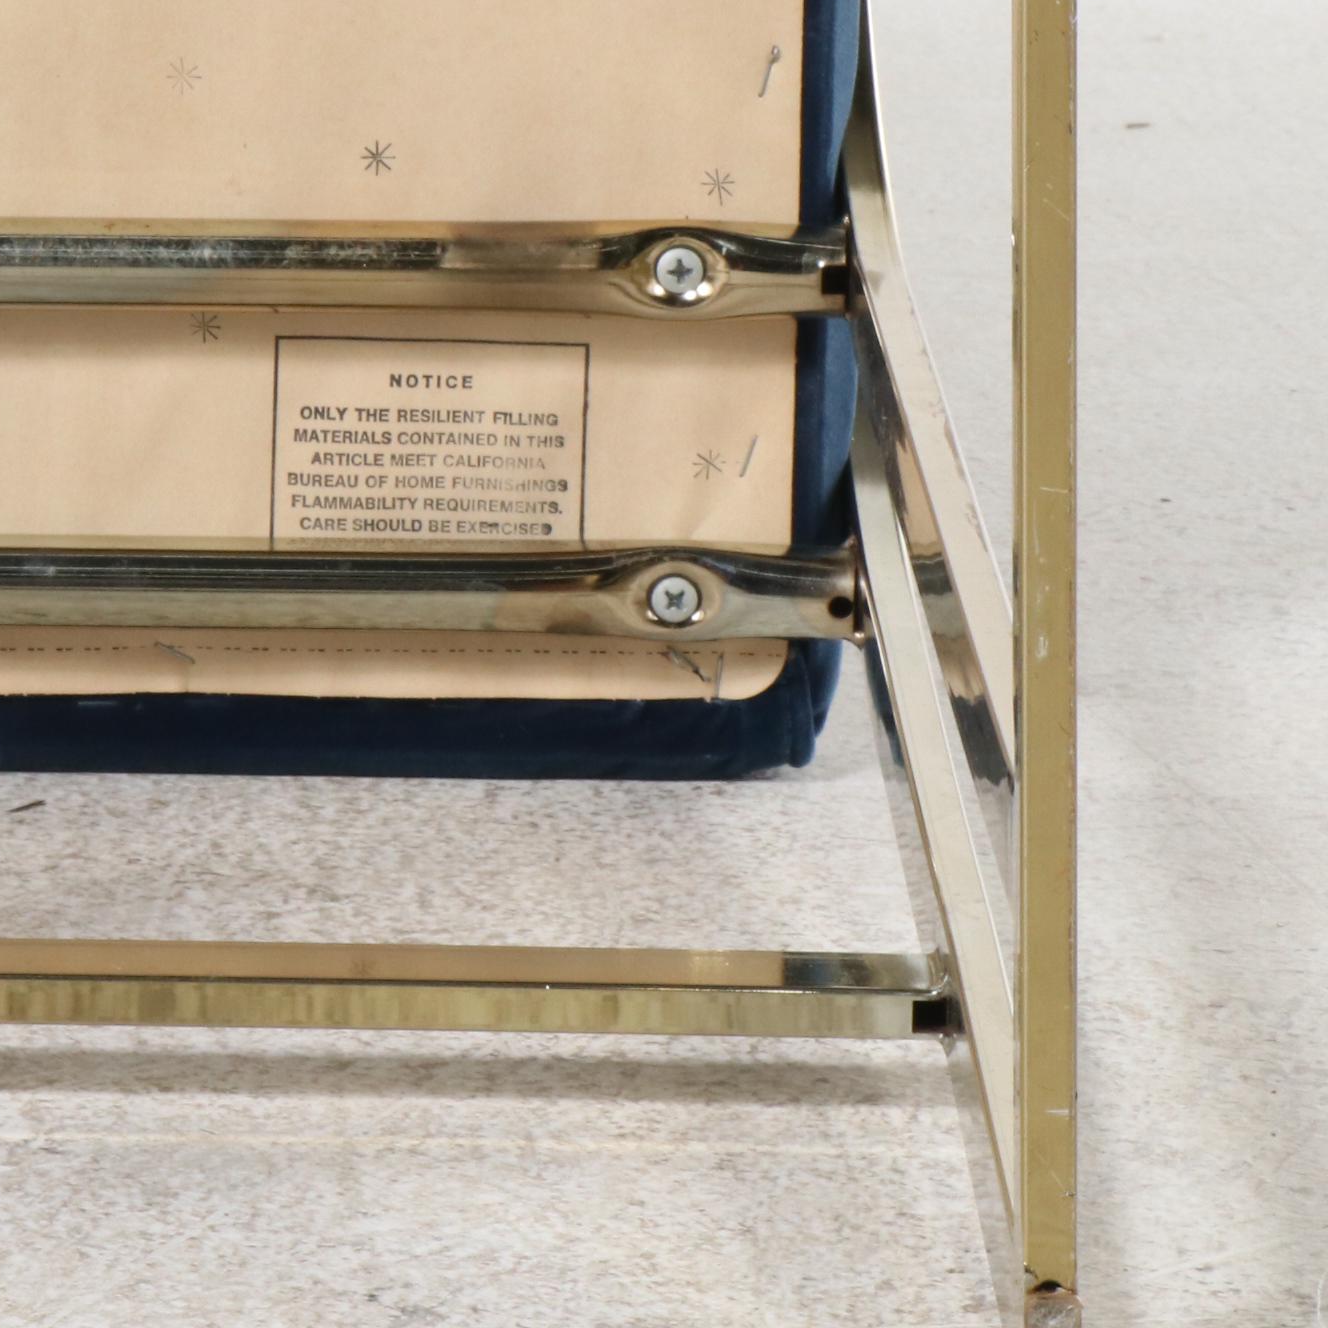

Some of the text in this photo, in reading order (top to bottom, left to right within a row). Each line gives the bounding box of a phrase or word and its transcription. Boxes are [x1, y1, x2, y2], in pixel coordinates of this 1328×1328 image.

[389, 374, 474, 389] NOTICE
[300, 406, 559, 426] ONLY THE RESILIENT FILLING
[293, 428, 565, 448] MATERIALS CONTAINED IN THIS
[311, 452, 546, 470] ARTICLE MEET CALIFORNIA
[287, 472, 568, 492] BUREAU OF HOME FURNISHINGS
[291, 495, 562, 515] FLAMMABILITY REQUIREMENTS.
[300, 517, 552, 536] CARE SHOULD BE EXERCISED
